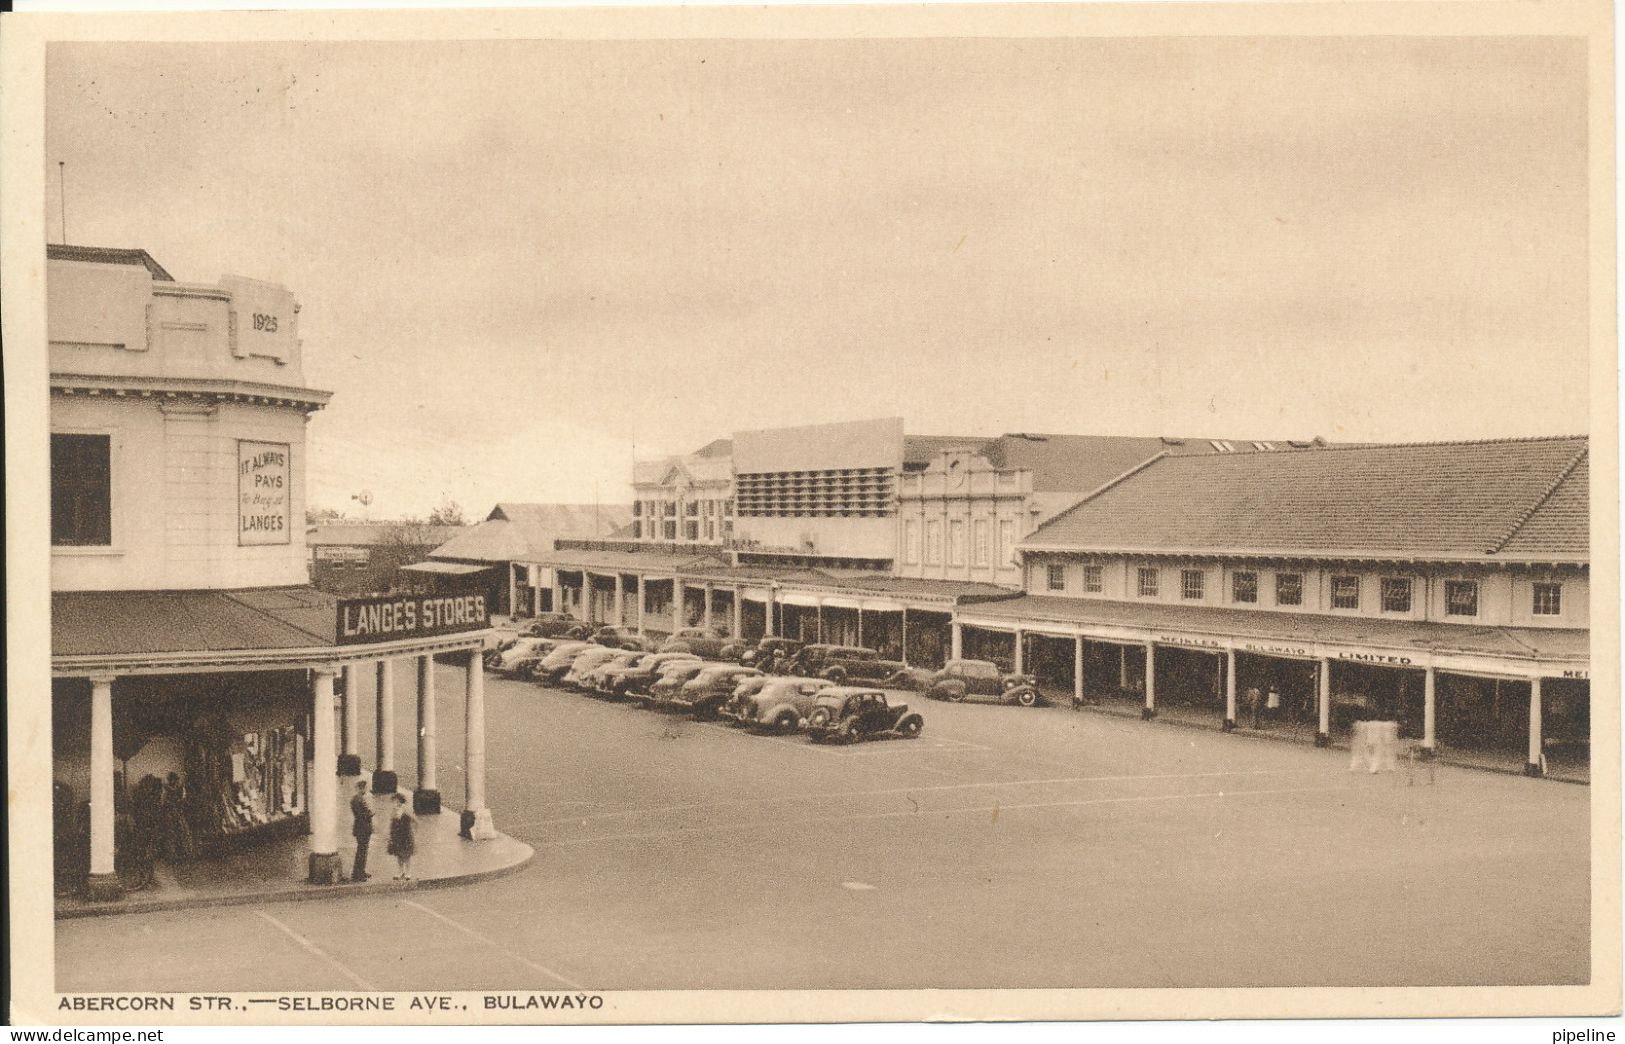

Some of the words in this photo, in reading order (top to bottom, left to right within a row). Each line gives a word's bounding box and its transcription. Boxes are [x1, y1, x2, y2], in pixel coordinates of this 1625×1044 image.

[241, 459, 250, 474] IT
[252, 452, 284, 472] ALWAYS
[255, 474, 283, 489] PAYS
[344, 600, 416, 637] LANGE'S
[422, 595, 485, 628] STORES
[1339, 652, 1412, 665] LIMITED
[58, 996, 175, 1011] ABERCORN
[409, 996, 468, 1013] AVE.,
[483, 994, 604, 1010] BULAWAYO
